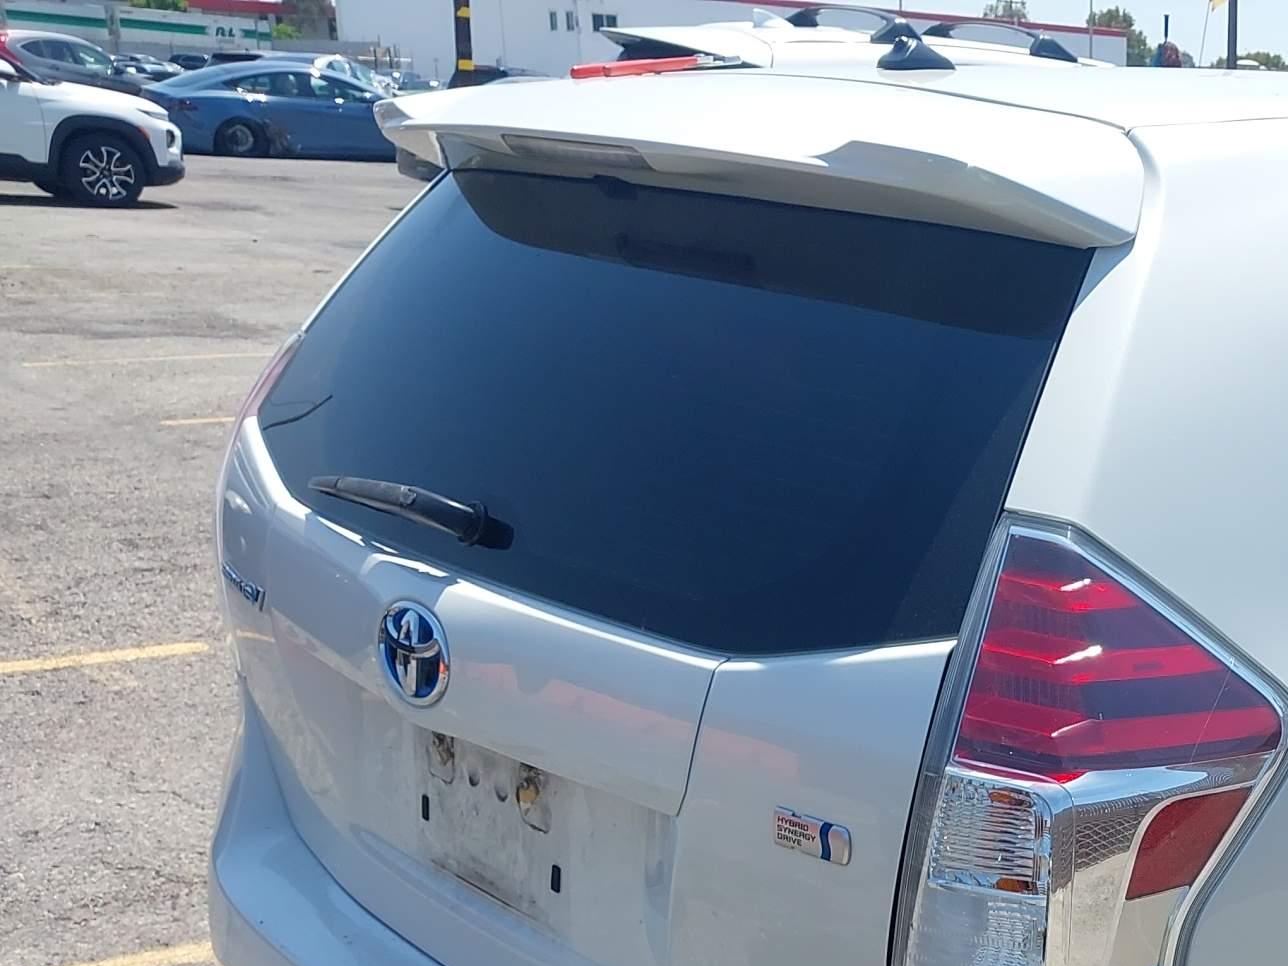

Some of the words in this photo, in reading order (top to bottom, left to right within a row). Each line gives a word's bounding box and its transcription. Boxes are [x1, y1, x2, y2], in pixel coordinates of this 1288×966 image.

[777, 815, 809, 832] HYBRID
[777, 824, 817, 843] SYNERGY
[777, 832, 803, 847] DRIVE
